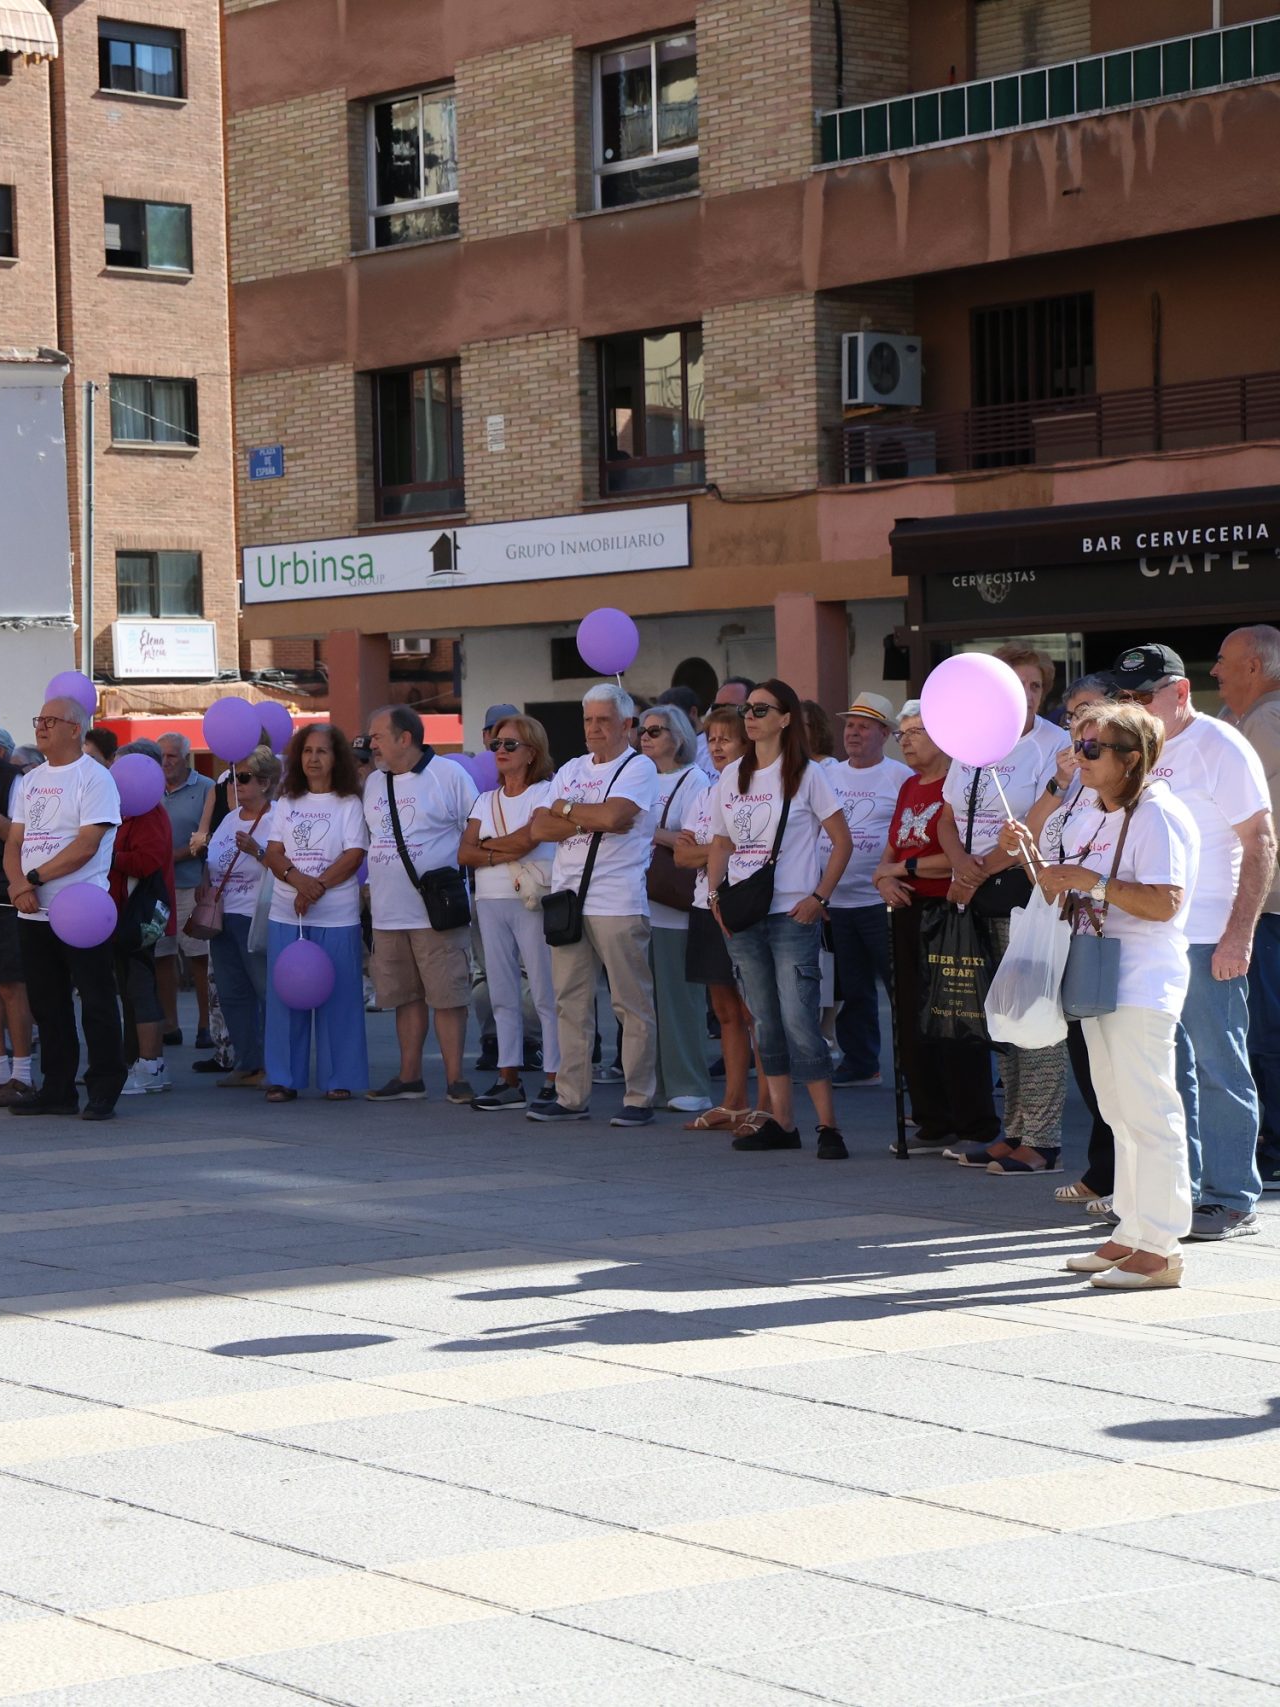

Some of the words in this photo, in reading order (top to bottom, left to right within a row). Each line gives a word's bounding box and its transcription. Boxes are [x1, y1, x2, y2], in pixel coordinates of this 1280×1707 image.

[1082, 535, 1122, 553] BAR
[1136, 523, 1269, 549] CERVECERIA
[257, 550, 375, 588] Urbinsa
[951, 570, 1036, 588] CERVECISTAS
[738, 793, 773, 803] AFAMSO
[299, 812, 332, 820] AFAMSO
